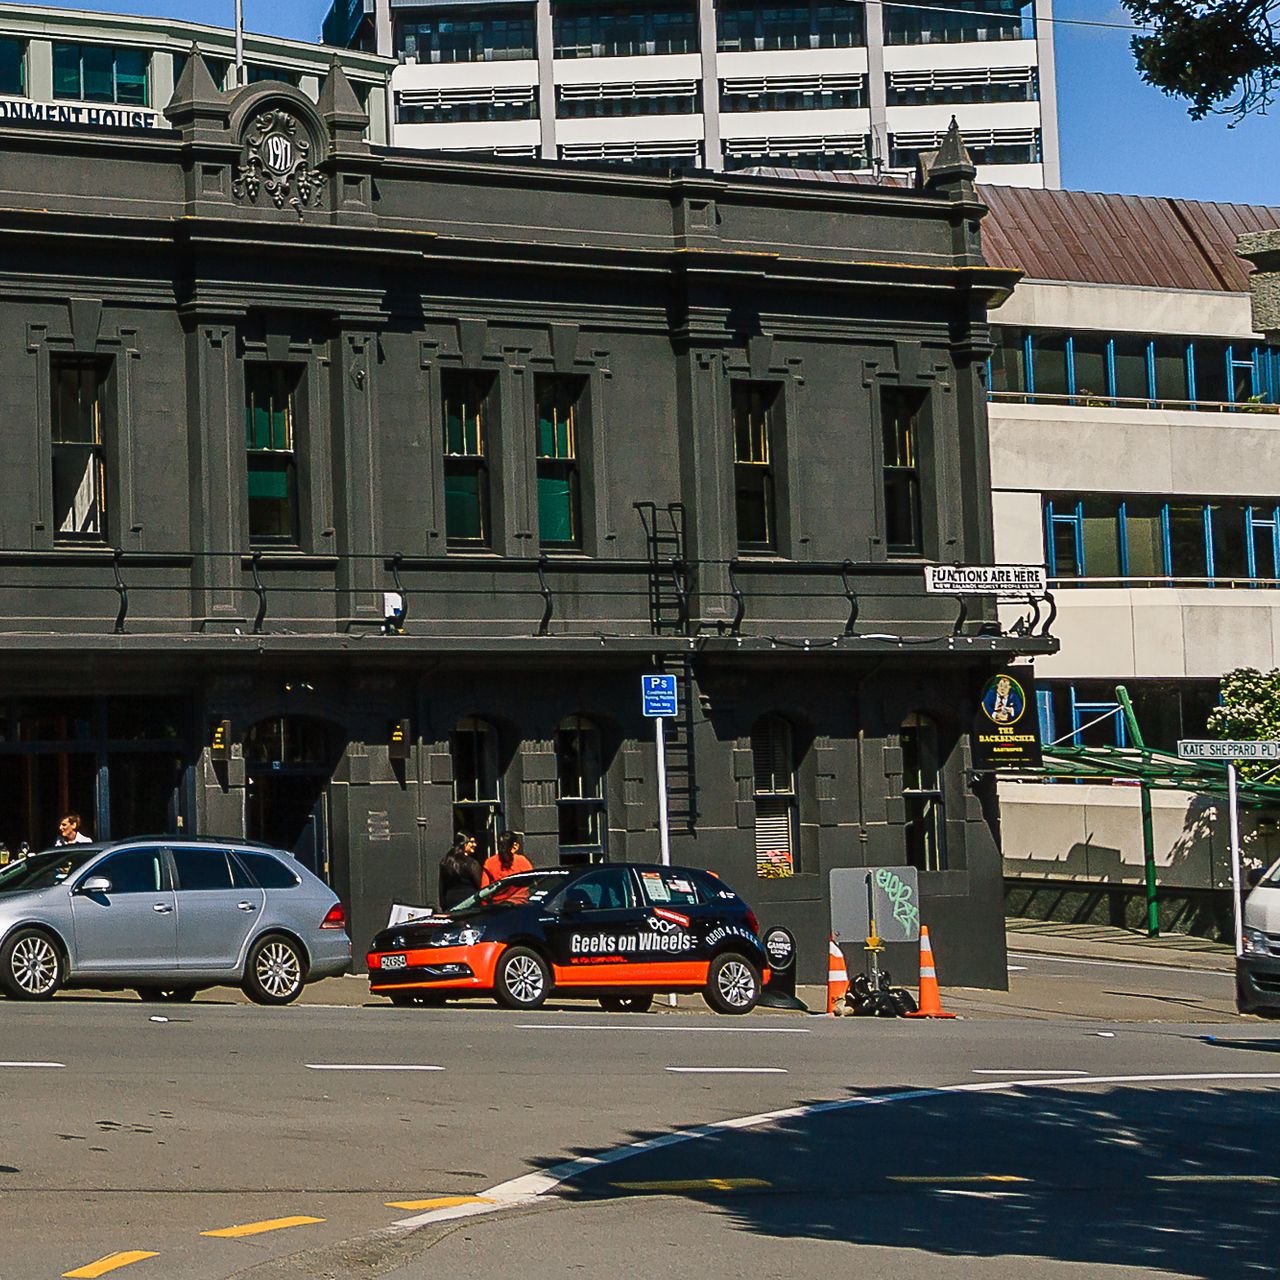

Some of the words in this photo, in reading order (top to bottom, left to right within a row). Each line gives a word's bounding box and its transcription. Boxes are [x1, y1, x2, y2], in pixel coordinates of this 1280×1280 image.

[88, 108, 155, 128] HOUSE
[268, 137, 291, 170] 1917
[991, 570, 1012, 582] ARE
[1014, 570, 1040, 582] HERE
[1183, 744, 1205, 755] KATE
[1209, 744, 1256, 756] SHEPPARD
[1261, 745, 1273, 756] PL
[571, 934, 616, 953] Geeks
[618, 936, 637, 952] on
[638, 932, 691, 952] Wheels
[767, 942, 791, 951] GAMING
